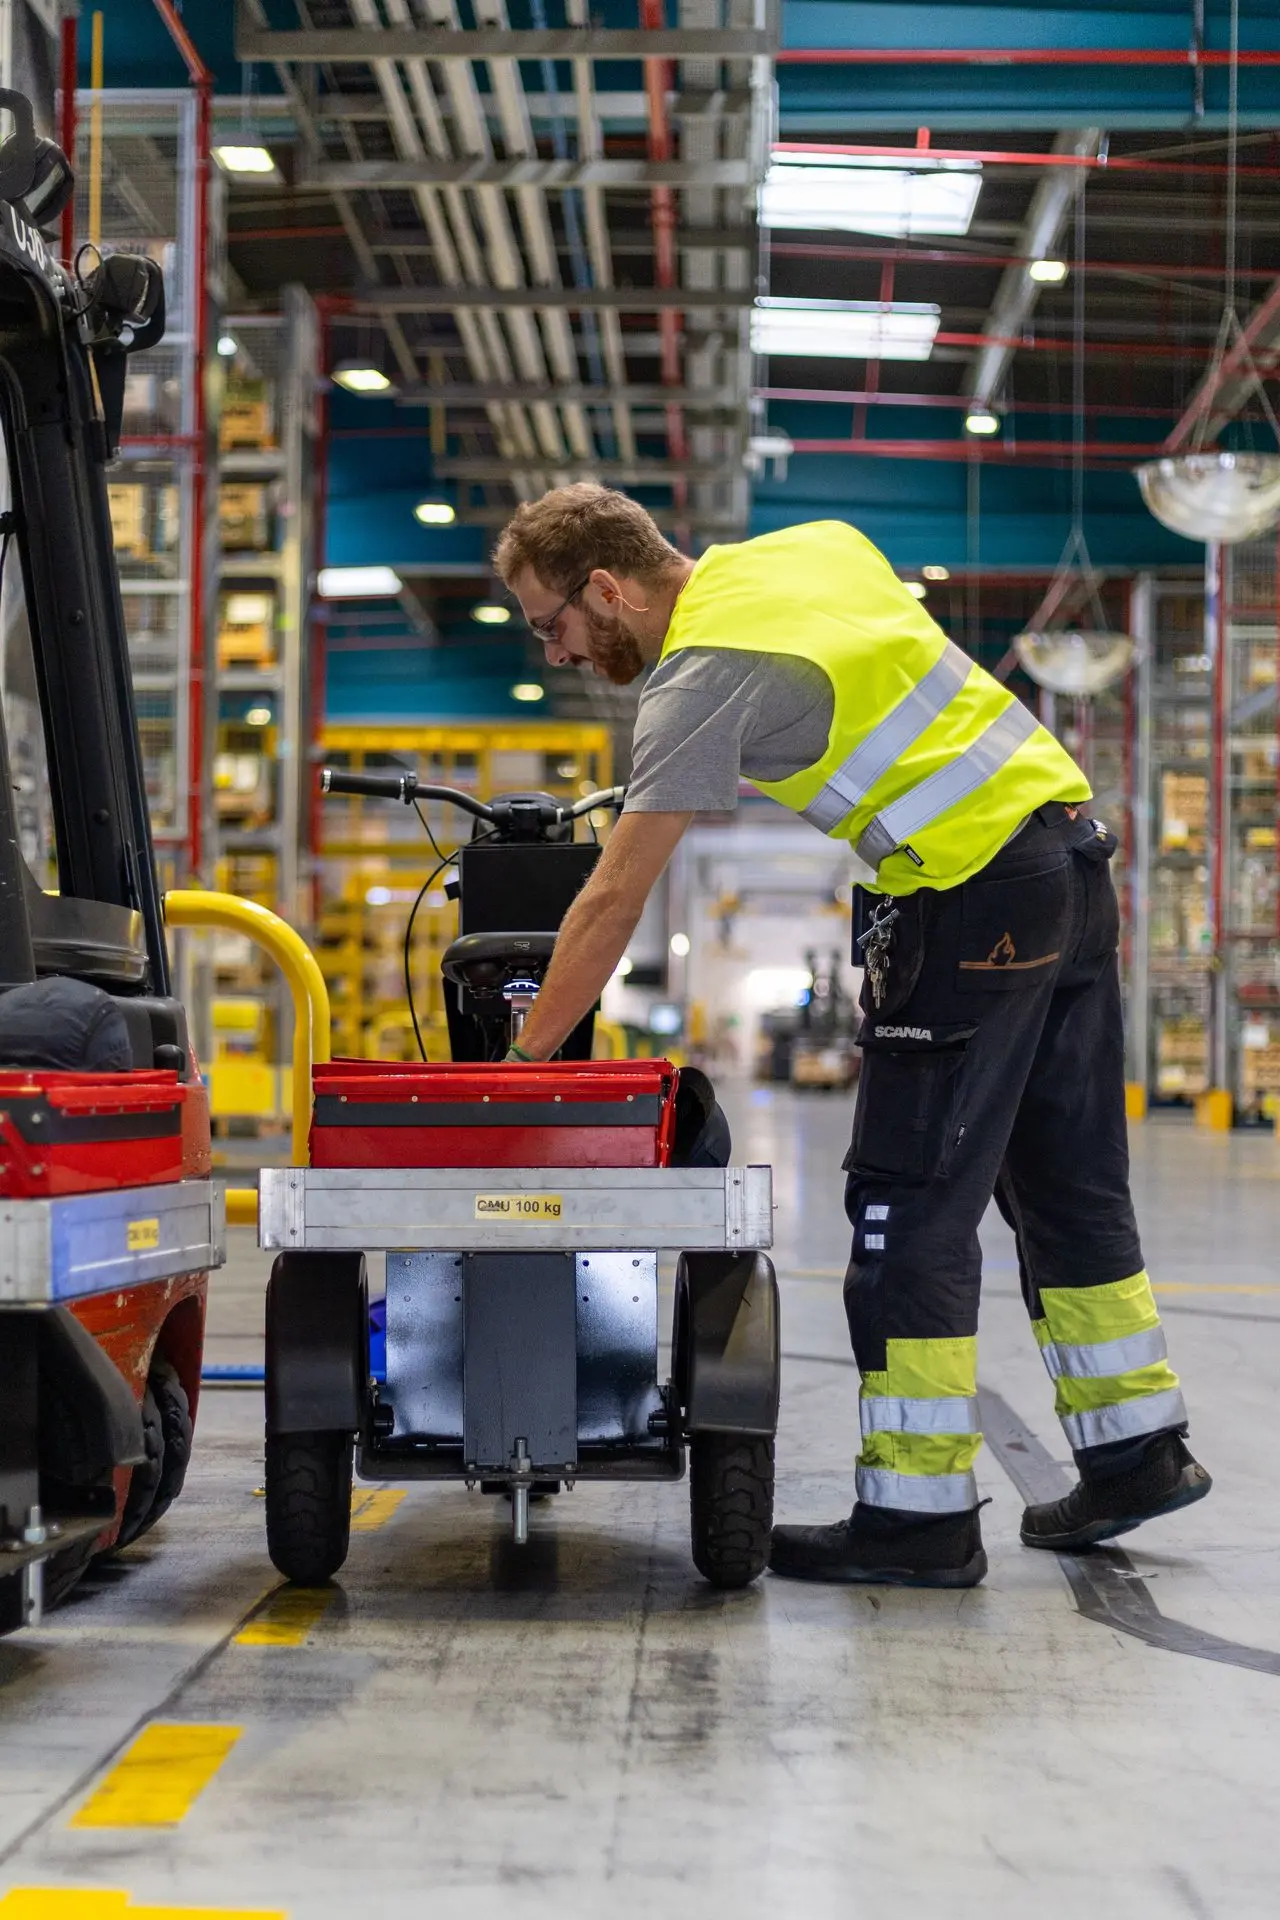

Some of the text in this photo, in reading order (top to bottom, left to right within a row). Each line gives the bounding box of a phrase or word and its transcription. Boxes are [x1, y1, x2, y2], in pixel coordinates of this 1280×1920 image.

[875, 1026, 932, 1041] SCANIA
[516, 1201, 540, 1213] 100
[544, 1202, 561, 1216] kg
